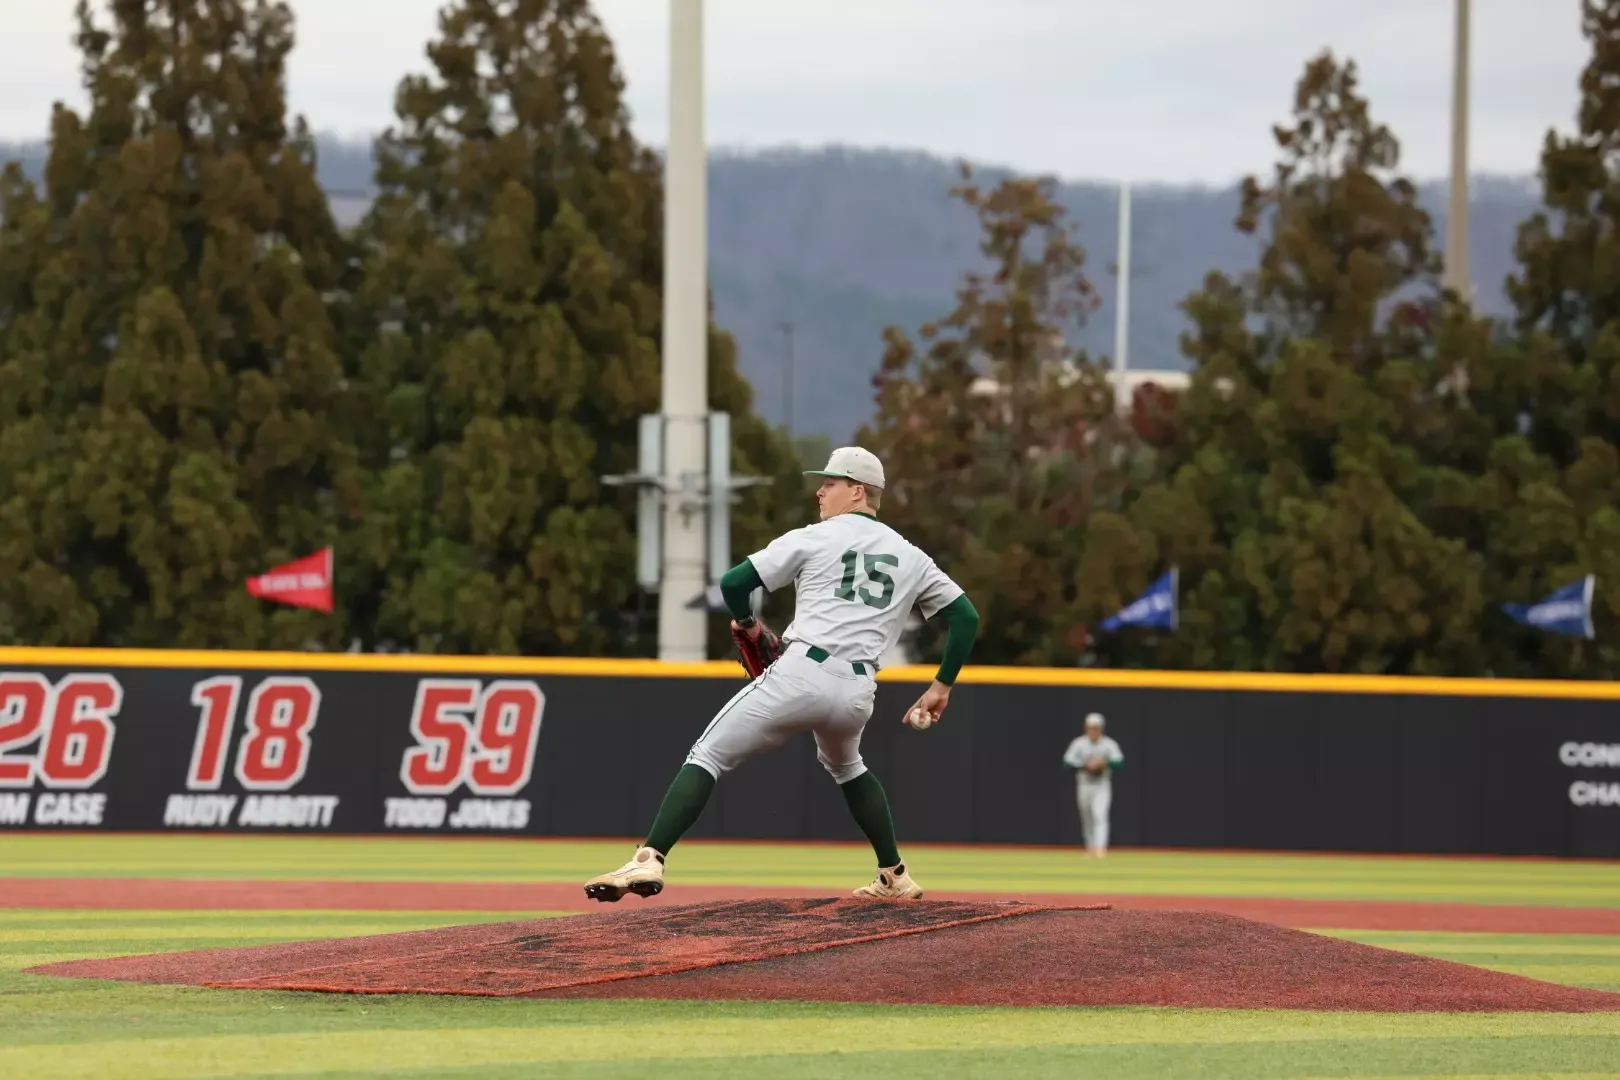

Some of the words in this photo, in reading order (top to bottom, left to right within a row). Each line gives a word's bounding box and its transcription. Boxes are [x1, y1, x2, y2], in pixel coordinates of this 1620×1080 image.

[834, 550, 899, 610] 15
[0, 672, 124, 789] 26
[186, 675, 322, 791] 18
[400, 678, 546, 796] 59
[34, 793, 107, 825] CASE
[163, 794, 238, 826] RUDY
[237, 794, 340, 827] ABBOTT
[384, 797, 448, 828] TODD
[448, 799, 532, 828] JONES
